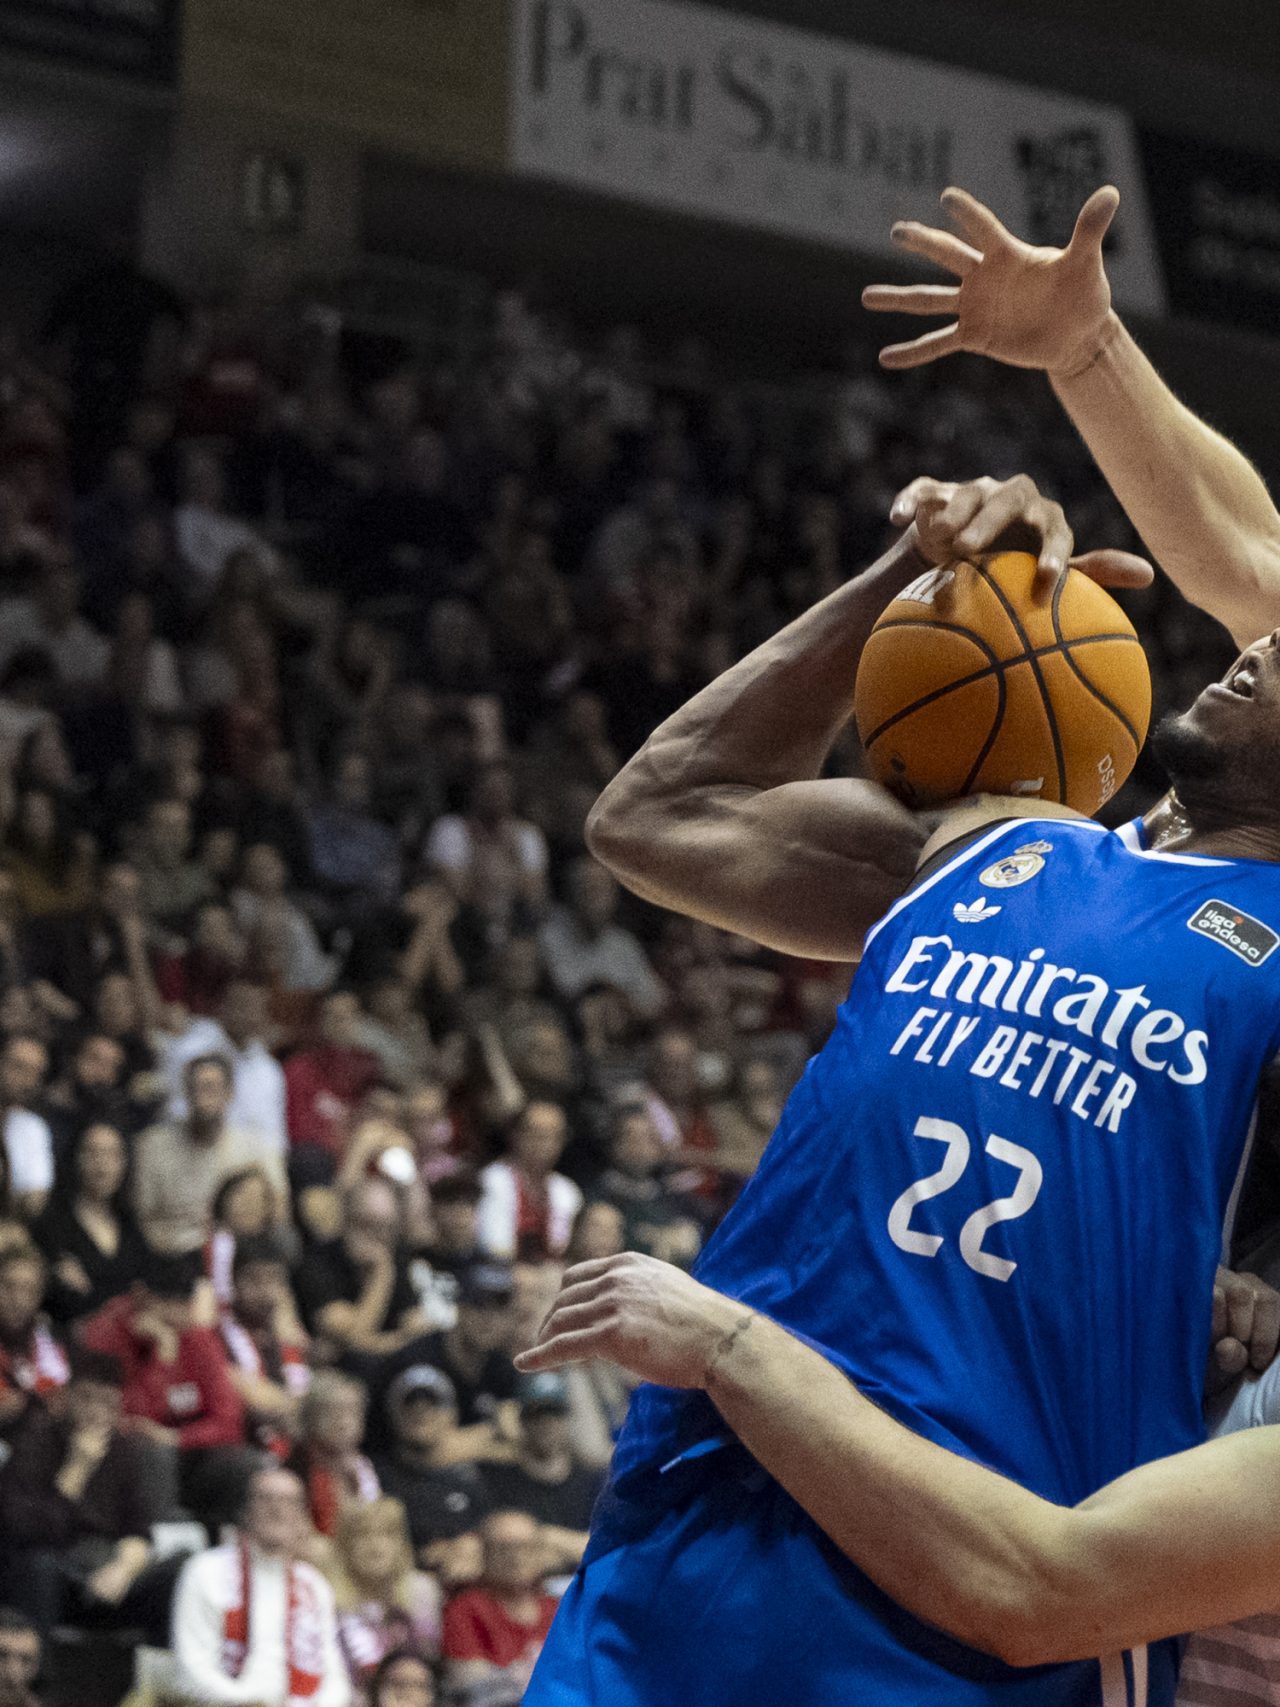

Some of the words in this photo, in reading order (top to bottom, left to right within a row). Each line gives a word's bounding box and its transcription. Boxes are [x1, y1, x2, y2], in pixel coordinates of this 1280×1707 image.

[1198, 918, 1261, 960] endesa
[1204, 909, 1237, 930] liga
[885, 934, 1210, 1086] Emirates
[889, 1006, 982, 1068] FLY
[968, 1023, 1139, 1135] BETTER
[887, 1115, 1045, 1284] 22
